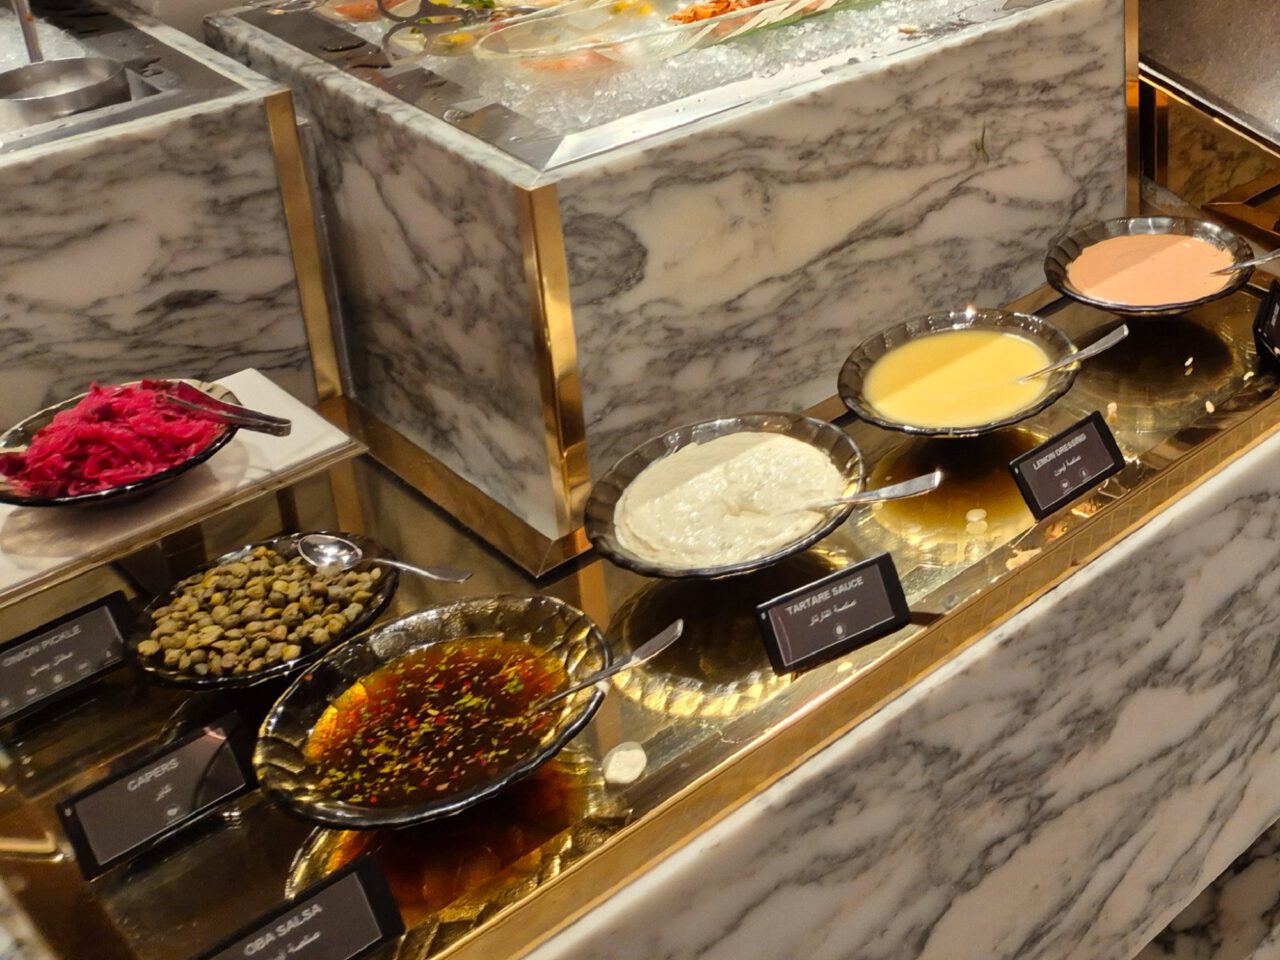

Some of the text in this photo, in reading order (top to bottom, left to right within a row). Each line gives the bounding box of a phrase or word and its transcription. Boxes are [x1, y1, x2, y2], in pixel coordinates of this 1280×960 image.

[1032, 432, 1087, 471] LEMON DRESSING
[785, 575, 865, 616] TARTARE SAUCE
[126, 758, 180, 792] CAPERS
[275, 903, 324, 938] SALSA
